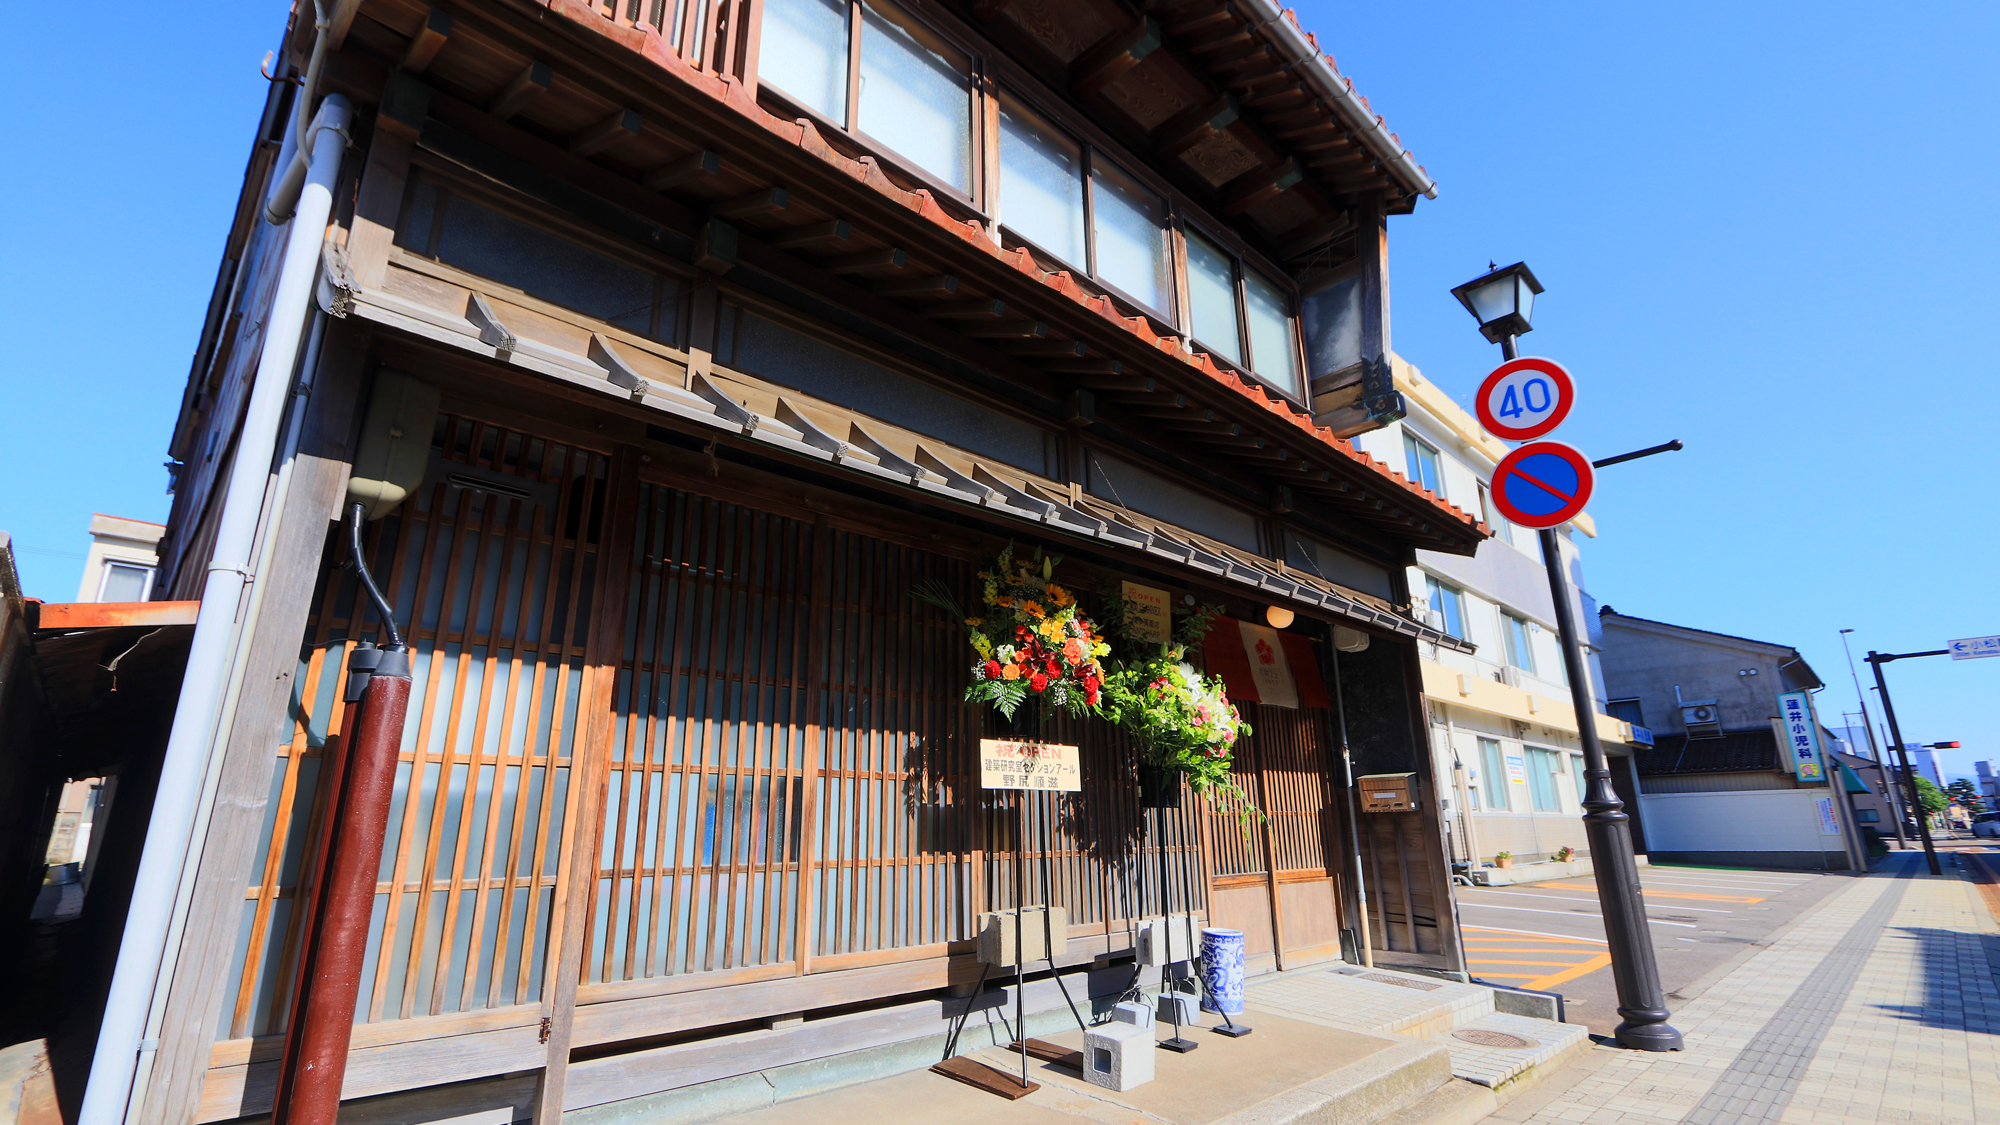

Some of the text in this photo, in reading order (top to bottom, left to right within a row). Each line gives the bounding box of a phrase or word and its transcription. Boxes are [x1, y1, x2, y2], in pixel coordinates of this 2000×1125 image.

[1500, 378, 1551, 418] 40
[1138, 593, 1161, 604] OPEN
[1969, 638, 2000, 650] 小松
[995, 743, 1062, 760] 祝 OPEN
[984, 758, 1076, 775] 建築研究室セクションアール
